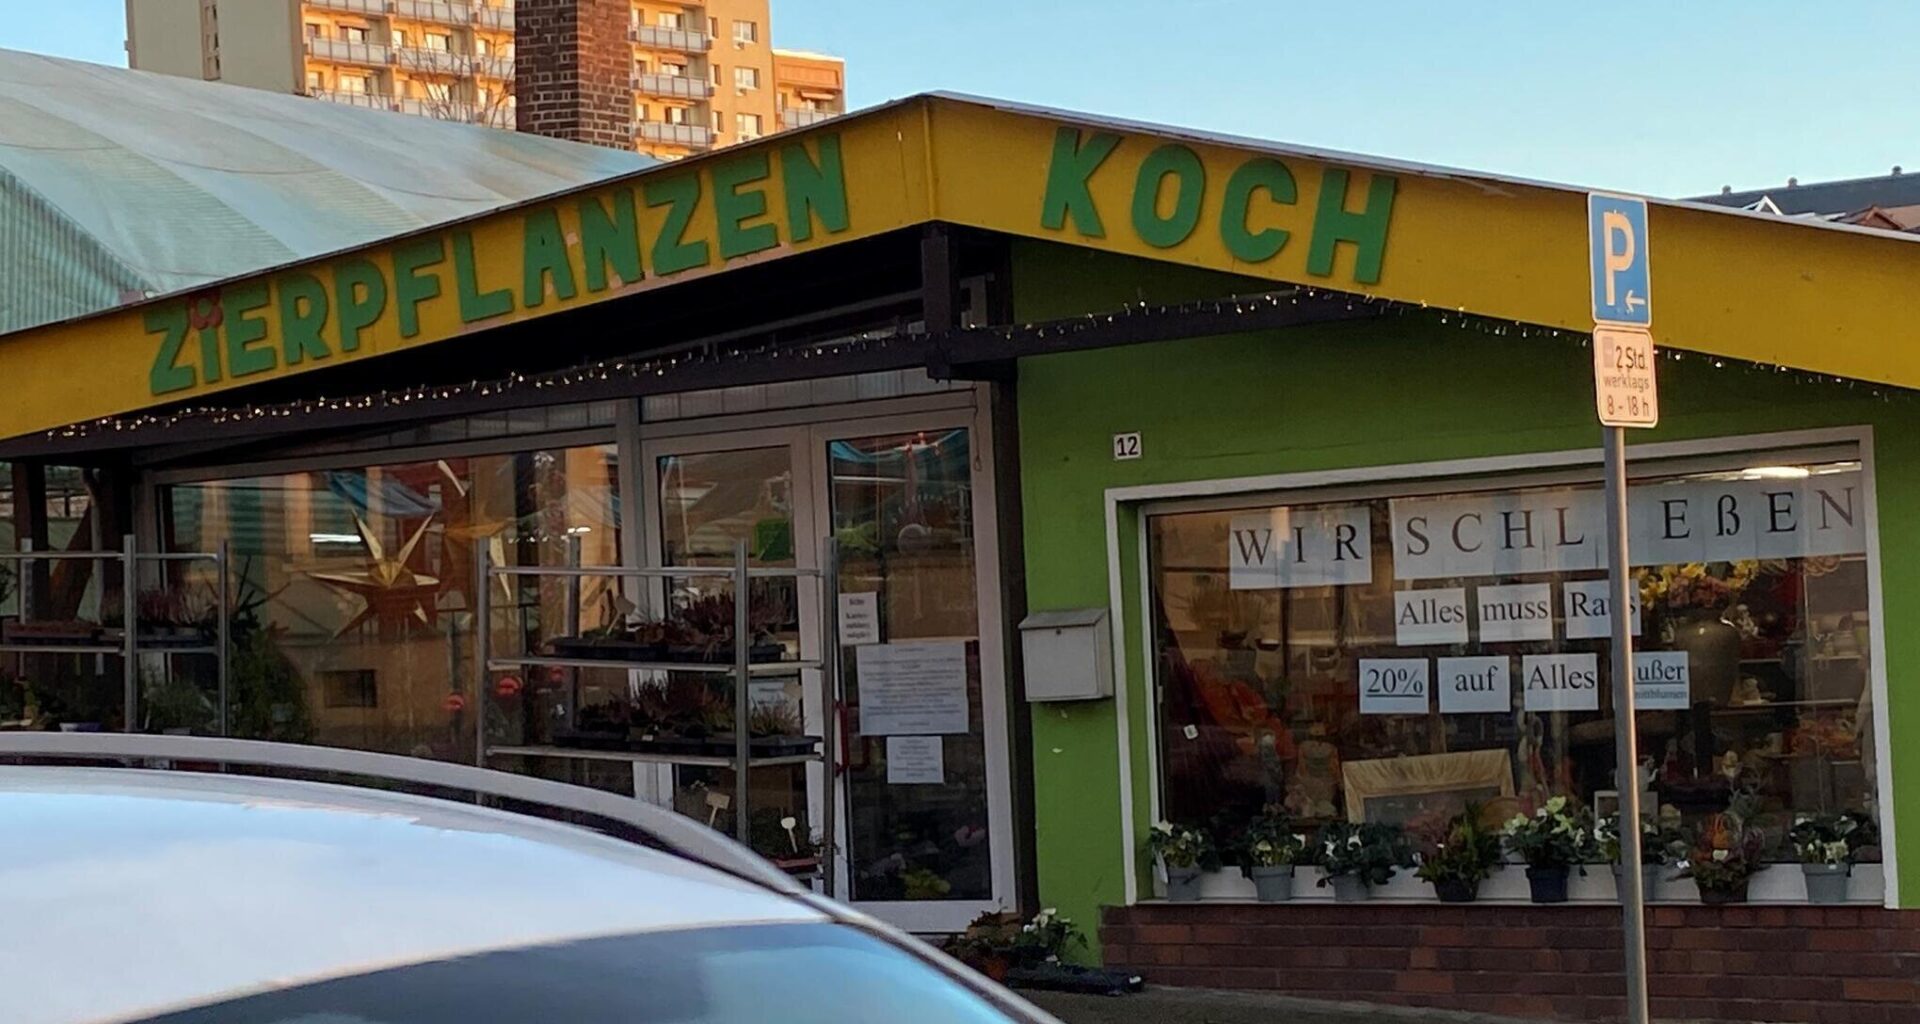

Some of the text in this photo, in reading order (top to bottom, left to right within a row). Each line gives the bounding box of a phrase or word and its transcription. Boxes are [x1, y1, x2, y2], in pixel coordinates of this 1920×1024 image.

[1041, 126, 1397, 285] KOCH
[1603, 211, 1635, 306] P
[1615, 345, 1649, 371] 2 Std.
[1607, 394, 1615, 416] 8
[1627, 394, 1639, 417] 18
[1642, 396, 1650, 417] h
[1117, 435, 1139, 457] 12
[1234, 486, 1855, 566] WIR SCHLEßEN
[1398, 592, 1636, 626] Alles muss Ras
[1366, 659, 1686, 695] 20% auf Alles ußer
